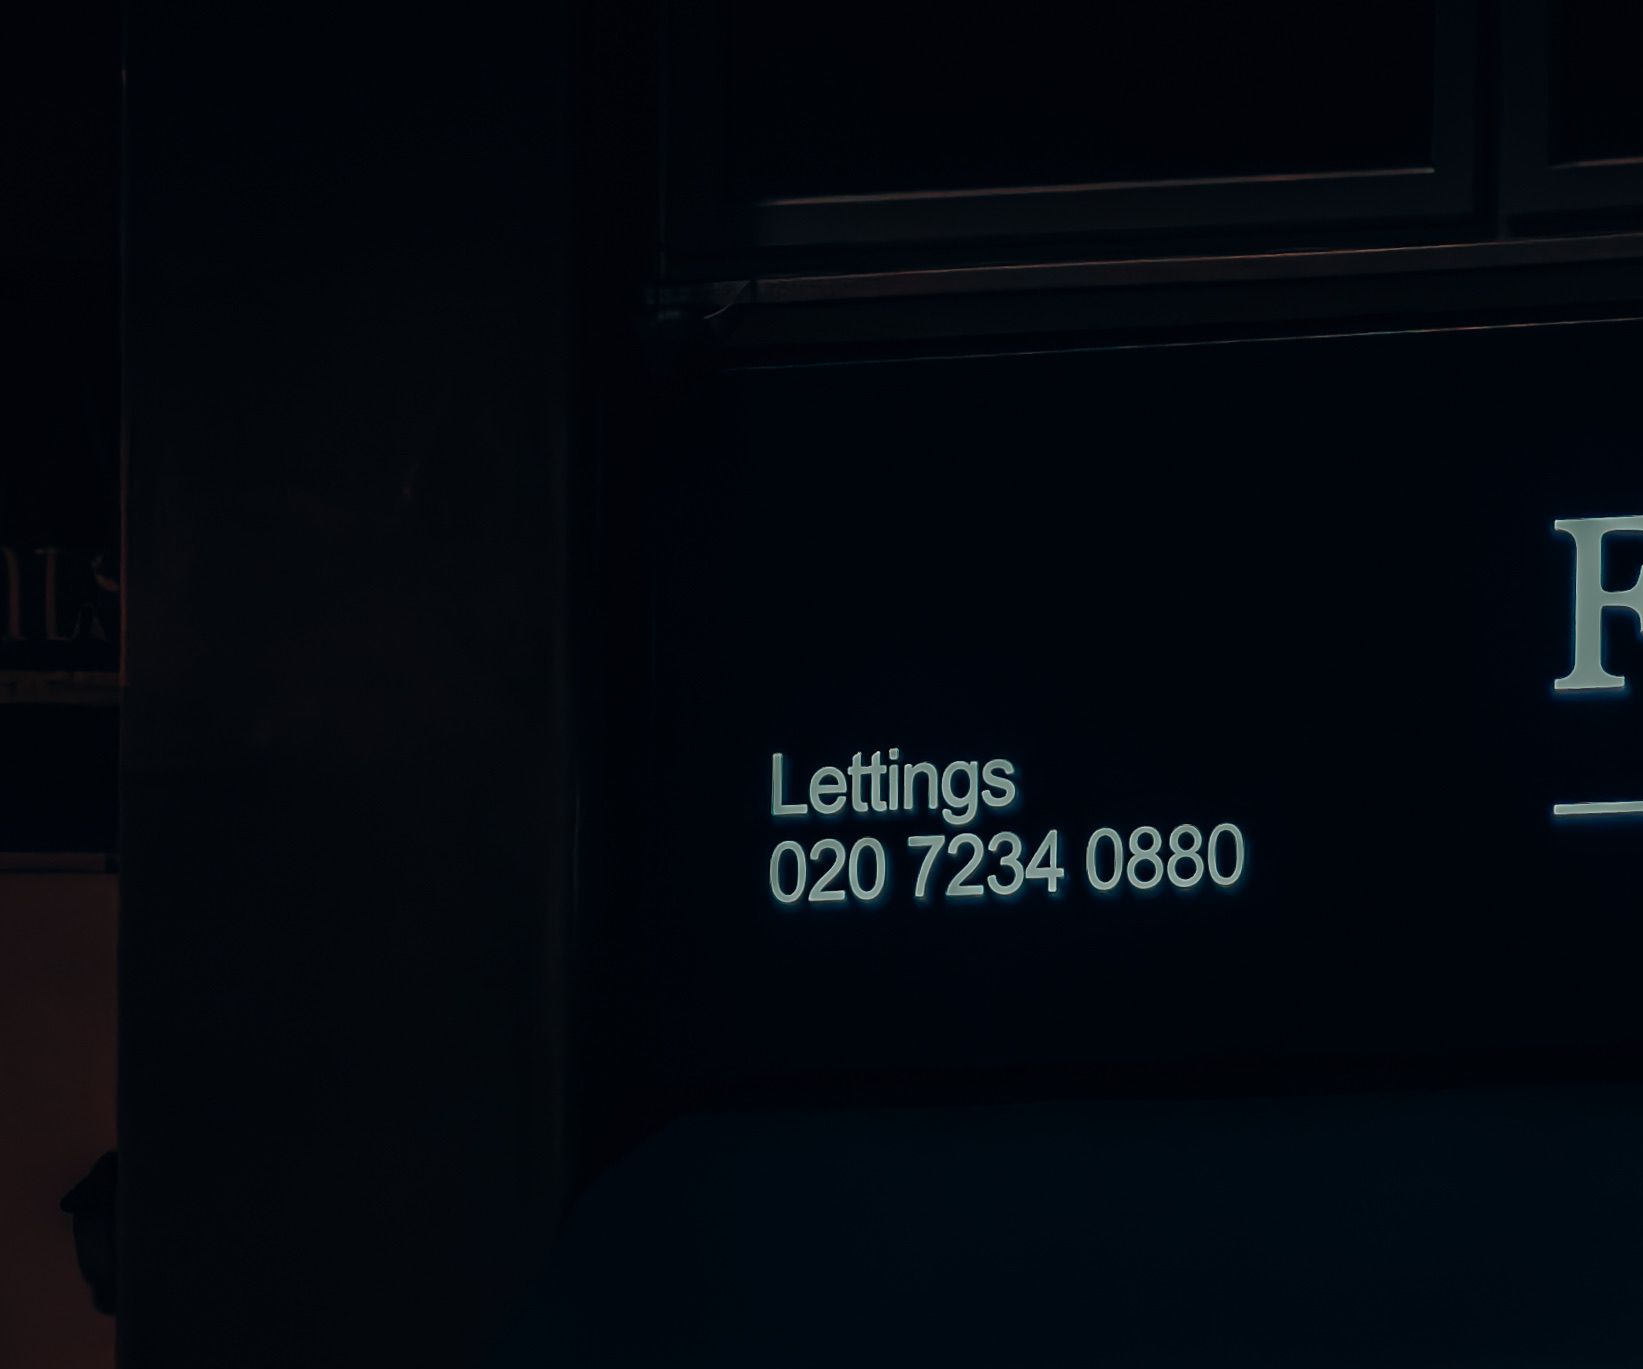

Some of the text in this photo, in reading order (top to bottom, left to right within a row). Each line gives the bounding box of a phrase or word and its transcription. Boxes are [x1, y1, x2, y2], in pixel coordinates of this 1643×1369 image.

[771, 747, 1017, 825] Lettings
[769, 822, 1246, 903] 020 7234 0880
